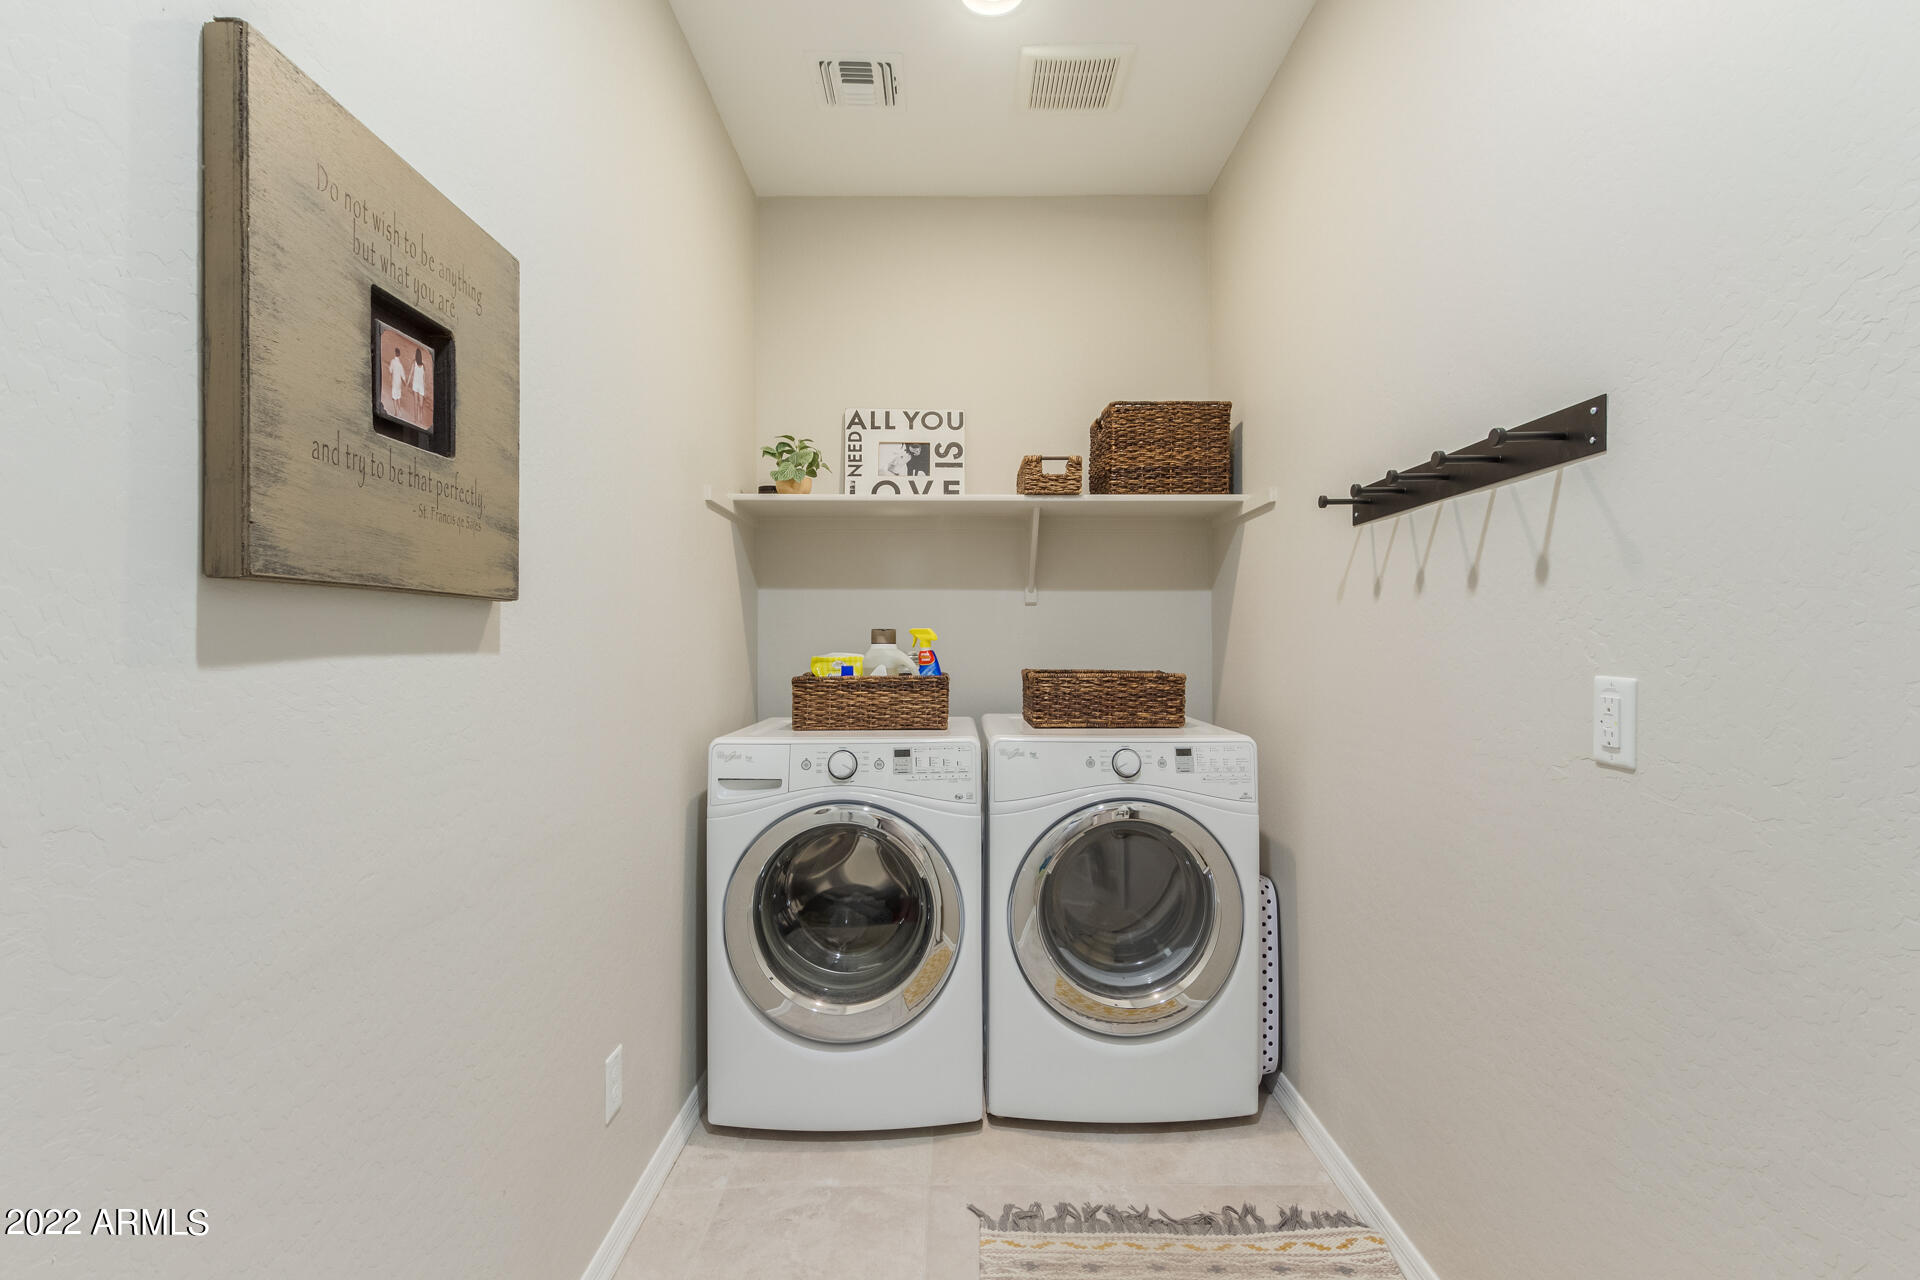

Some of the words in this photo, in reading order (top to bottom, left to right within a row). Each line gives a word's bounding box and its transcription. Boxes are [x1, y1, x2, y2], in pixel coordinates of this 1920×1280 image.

[316, 162, 339, 202] Do
[344, 191, 369, 225] not
[372, 210, 400, 250] wish
[404, 231, 417, 260] to
[420, 231, 435, 273] be
[438, 262, 483, 317] anything
[352, 217, 377, 267] but
[379, 244, 410, 289] what
[413, 277, 435, 307] you
[846, 409, 896, 431] ALL
[902, 410, 965, 431] YOU
[311, 430, 340, 466] and
[345, 444, 366, 488] try
[370, 452, 385, 480] to
[389, 448, 404, 485] be
[408, 457, 433, 493] that
[847, 430, 864, 477] NEED
[934, 441, 964, 469] IS
